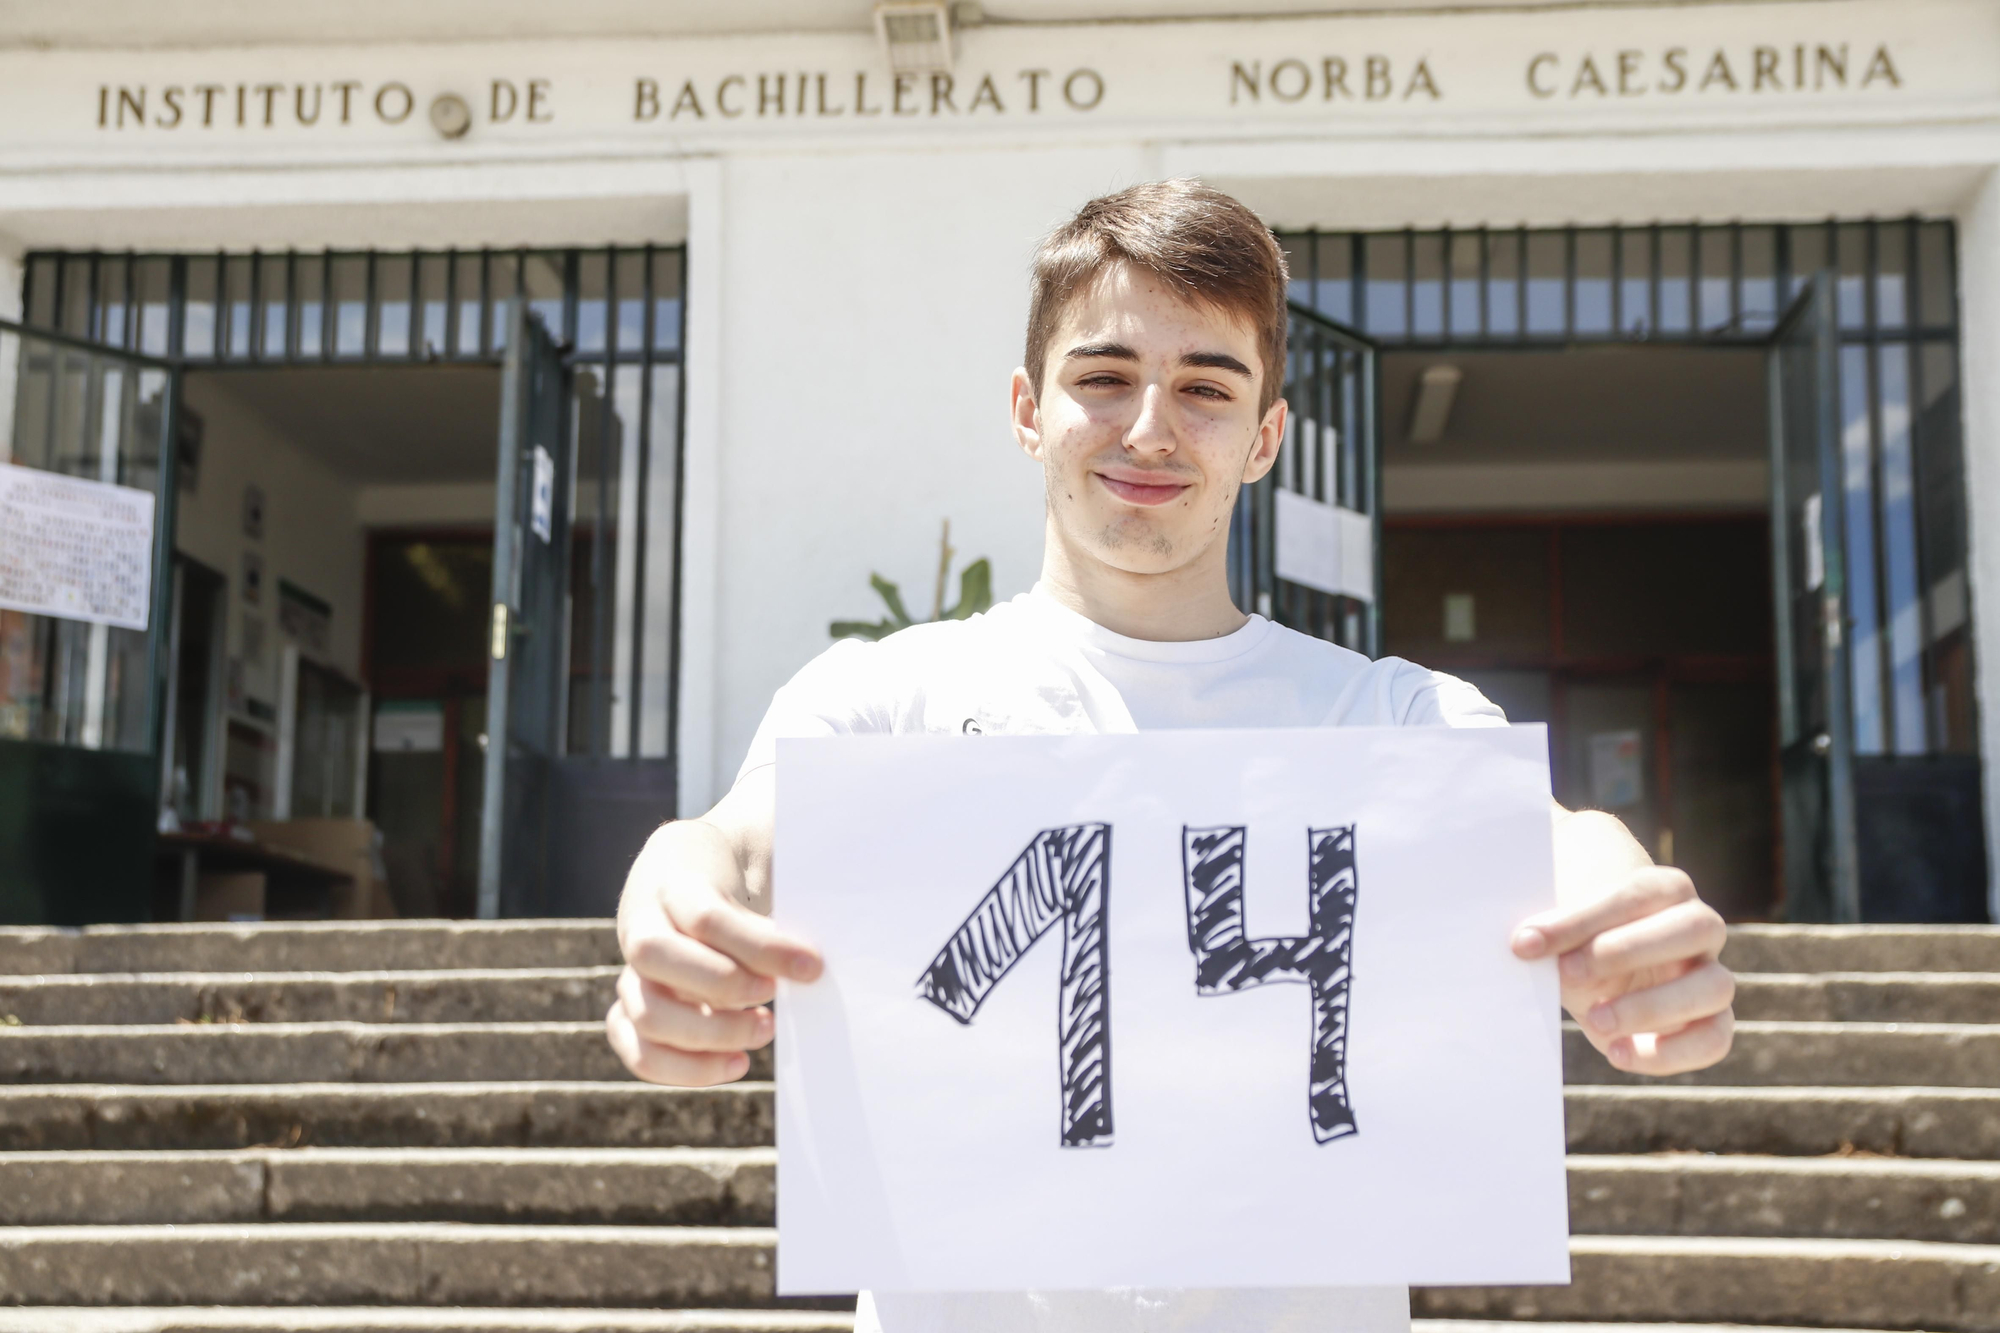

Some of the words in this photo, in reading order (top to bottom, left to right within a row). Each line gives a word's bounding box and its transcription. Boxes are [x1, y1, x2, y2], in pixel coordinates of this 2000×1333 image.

[96, 82, 414, 128] INSTITUTO
[490, 78, 554, 124] DE
[633, 68, 1106, 122] BACHILLERATO
[1229, 54, 1442, 106] NORBA
[1525, 42, 1904, 99] CAESARINA
[915, 822, 1359, 1148] 14
